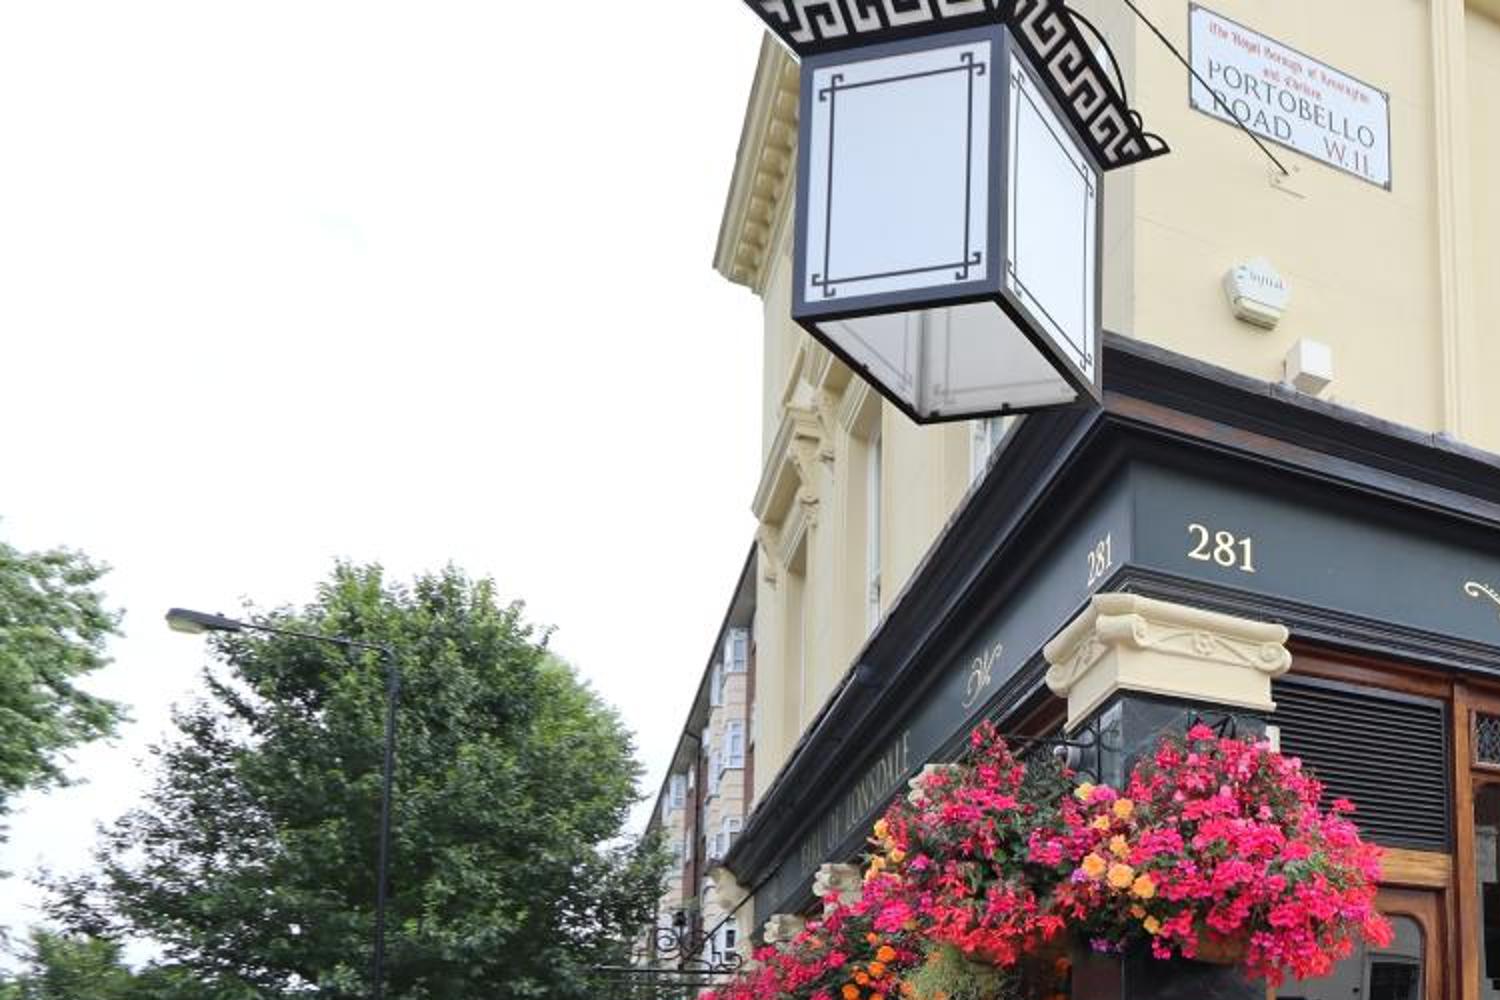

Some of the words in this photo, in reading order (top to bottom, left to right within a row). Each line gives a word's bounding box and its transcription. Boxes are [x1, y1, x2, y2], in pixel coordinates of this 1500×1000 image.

[1208, 57, 1375, 149] PORTOBELLO
[1087, 532, 1112, 588] 281
[1187, 523, 1256, 573] 281
